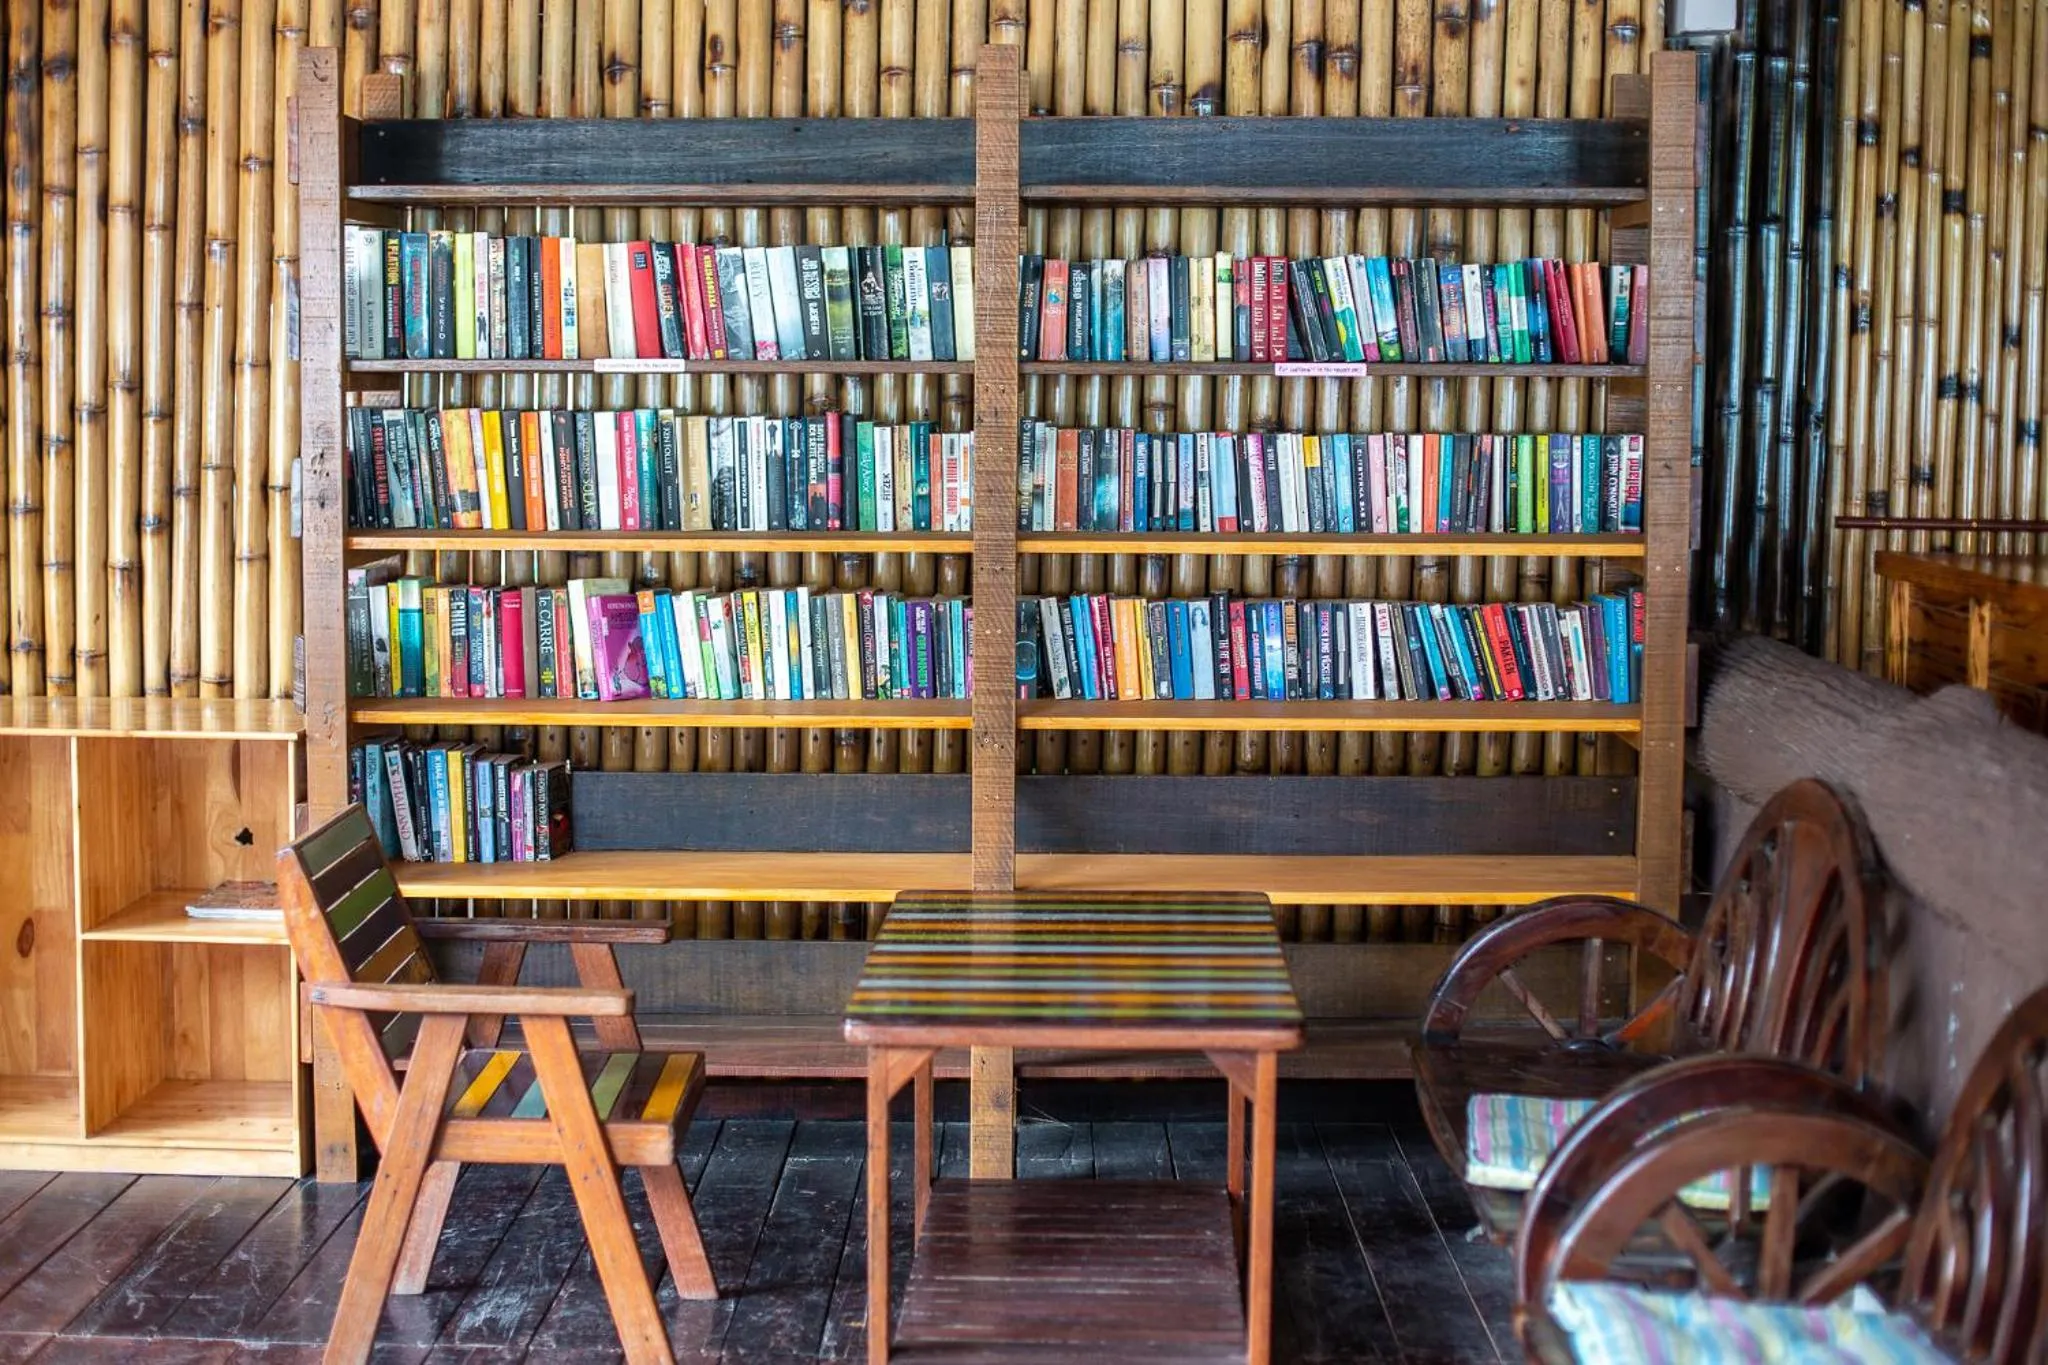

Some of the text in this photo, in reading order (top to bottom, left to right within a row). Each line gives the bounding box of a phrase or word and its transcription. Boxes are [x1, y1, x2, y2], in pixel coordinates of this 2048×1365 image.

[387, 246, 399, 285] PLATOON
[583, 478, 596, 515] SOLAR
[883, 473, 891, 501] FITZEK
[1607, 453, 1619, 518] JOHN CONNOLLY
[451, 601, 466, 636] CHILD
[539, 596, 553, 655] le CARRÉ
[863, 605, 873, 632] Bernard
[917, 635, 928, 688] GRANNEN
[1499, 640, 1516, 675] PAKTEN
[393, 779, 411, 840] THAILAND
